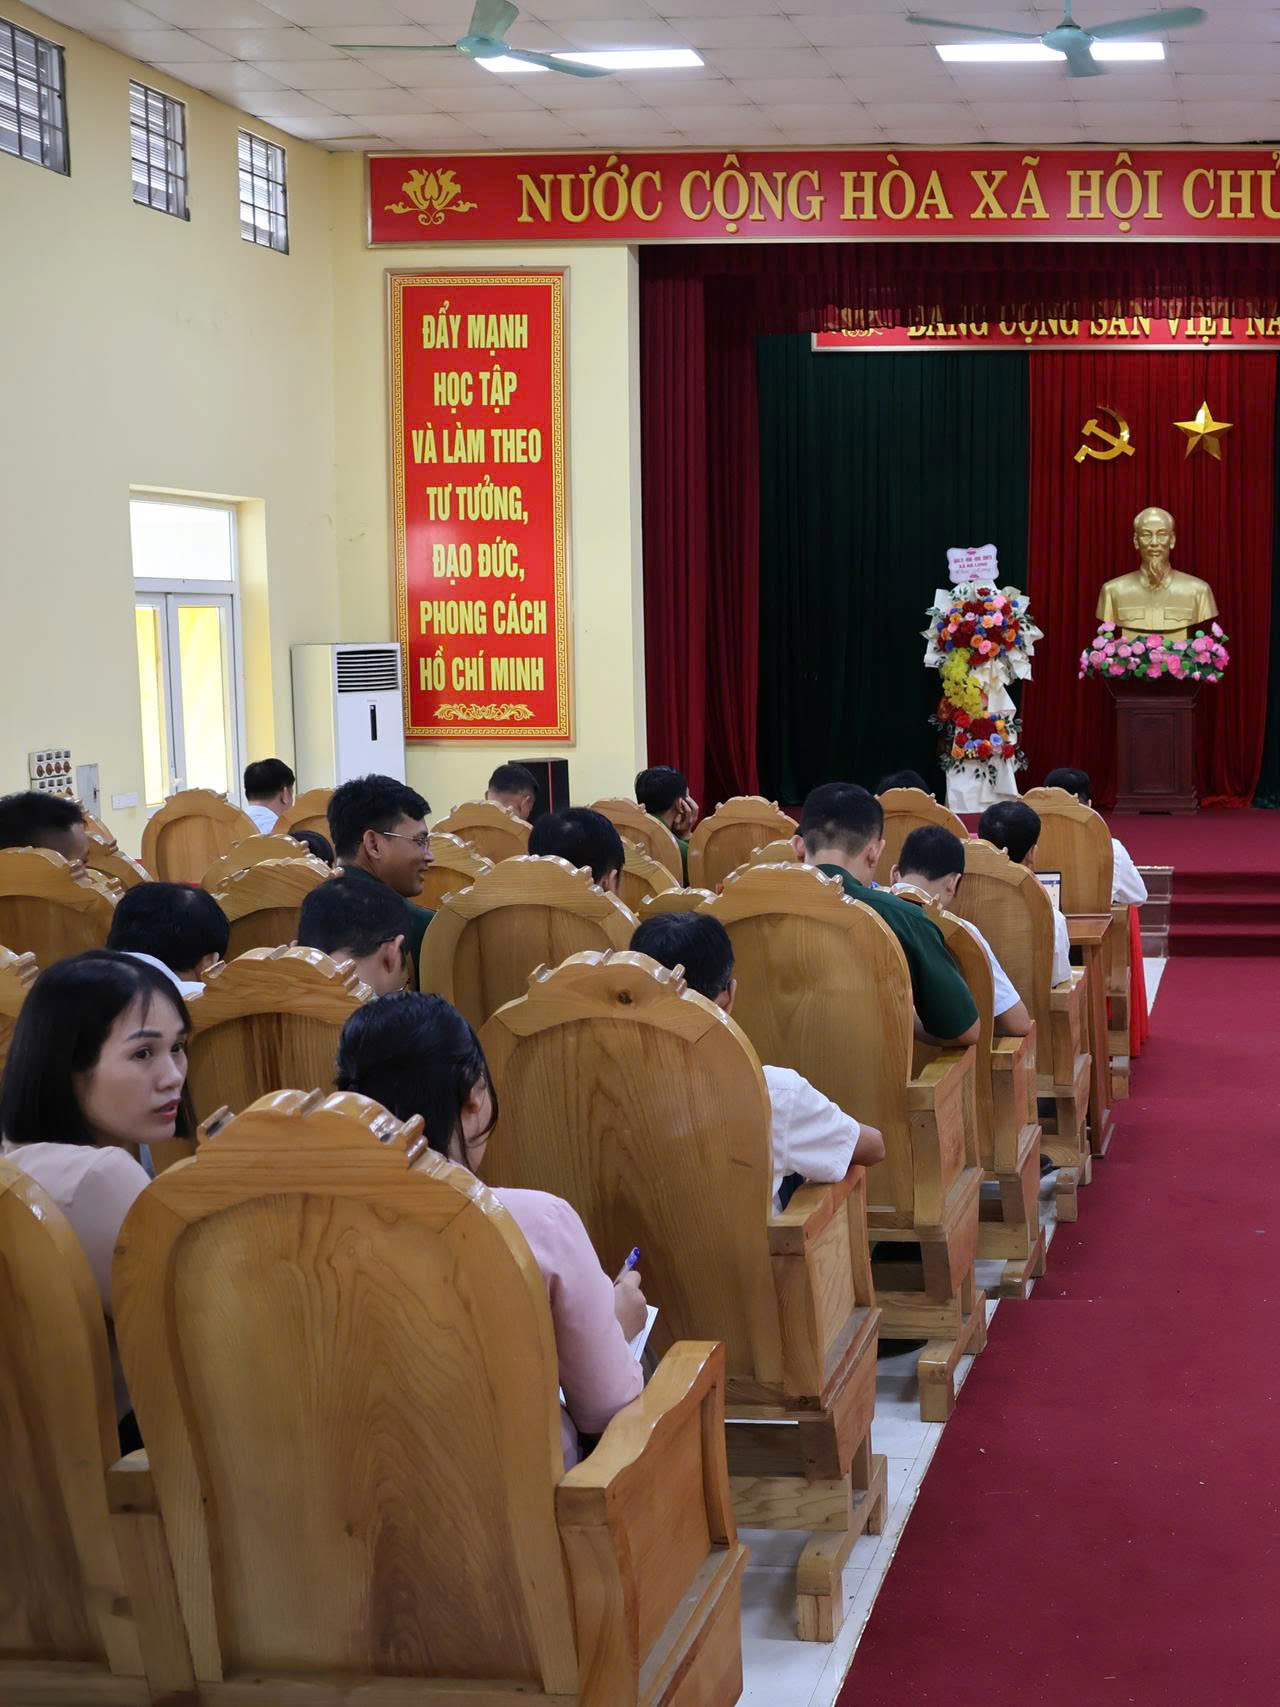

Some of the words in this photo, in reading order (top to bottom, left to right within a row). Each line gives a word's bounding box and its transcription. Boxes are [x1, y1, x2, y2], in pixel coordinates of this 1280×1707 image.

[517, 154, 663, 223] NƯỚC
[679, 154, 825, 235] CỘNG
[839, 154, 954, 220] HÒA
[970, 156, 1051, 219] XÃ
[1065, 152, 1164, 233] HỘI
[422, 300, 462, 349] ĐẨY
[467, 313, 528, 357] MẠNH
[433, 371, 474, 414] HỌC
[478, 364, 518, 414] TẬP
[411, 422, 438, 464] VÀ
[442, 421, 486, 464] LÀM
[490, 428, 542, 464] THEO
[426, 482, 453, 521] TƯ
[455, 474, 529, 525] TƯỞNG,
[431, 540, 473, 586] ĐẠO
[477, 535, 525, 582] ĐỨC,
[419, 599, 487, 635] PHONG
[492, 592, 547, 635] CÁCH
[419, 645, 446, 692] HỒ
[451, 649, 485, 692] CHÍ
[490, 656, 545, 691] MINH
